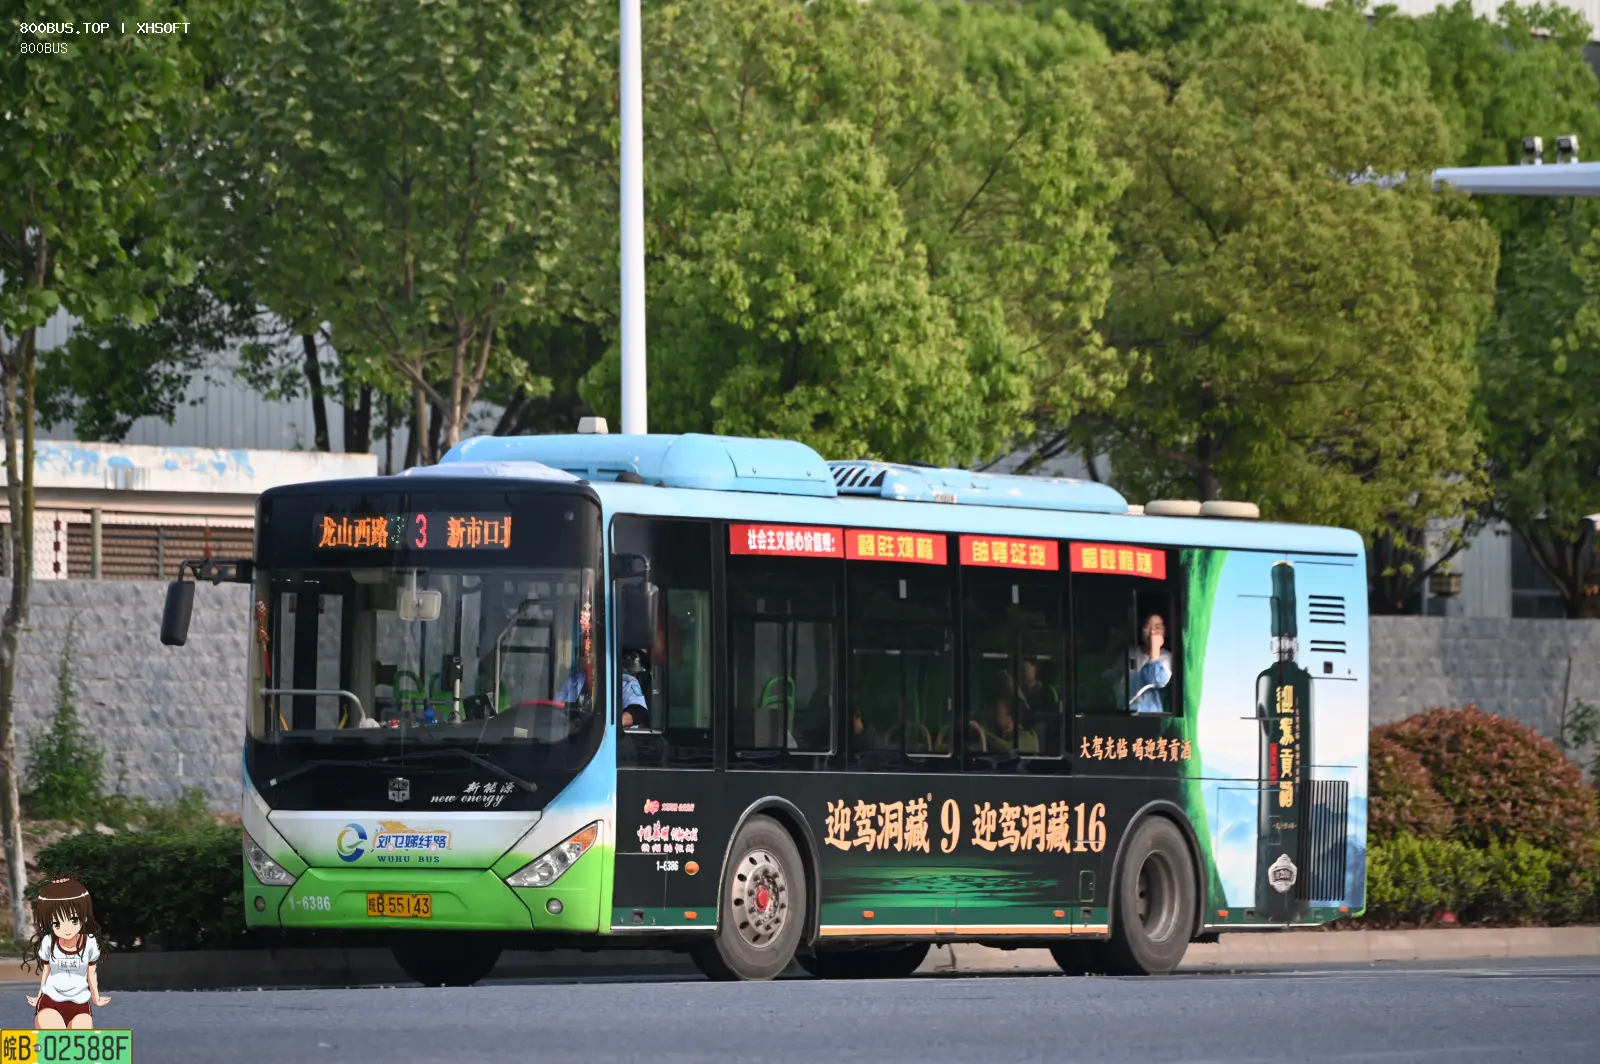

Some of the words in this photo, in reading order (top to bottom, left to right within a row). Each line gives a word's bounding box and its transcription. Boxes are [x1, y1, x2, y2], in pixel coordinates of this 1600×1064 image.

[319, 516, 388, 547] 龙山西路
[415, 514, 428, 548] 3
[1080, 735, 1128, 761] 大驾光临
[463, 781, 515, 795] 新能源
[430, 795, 458, 803] new
[460, 794, 506, 808] energy
[824, 797, 931, 853] 迎驾洞藏
[940, 798, 961, 854] 9
[377, 855, 411, 863] WUHU
[418, 855, 440, 863] BUS
[656, 861, 679, 872] 1-6386
[288, 895, 332, 911] 1-6386
